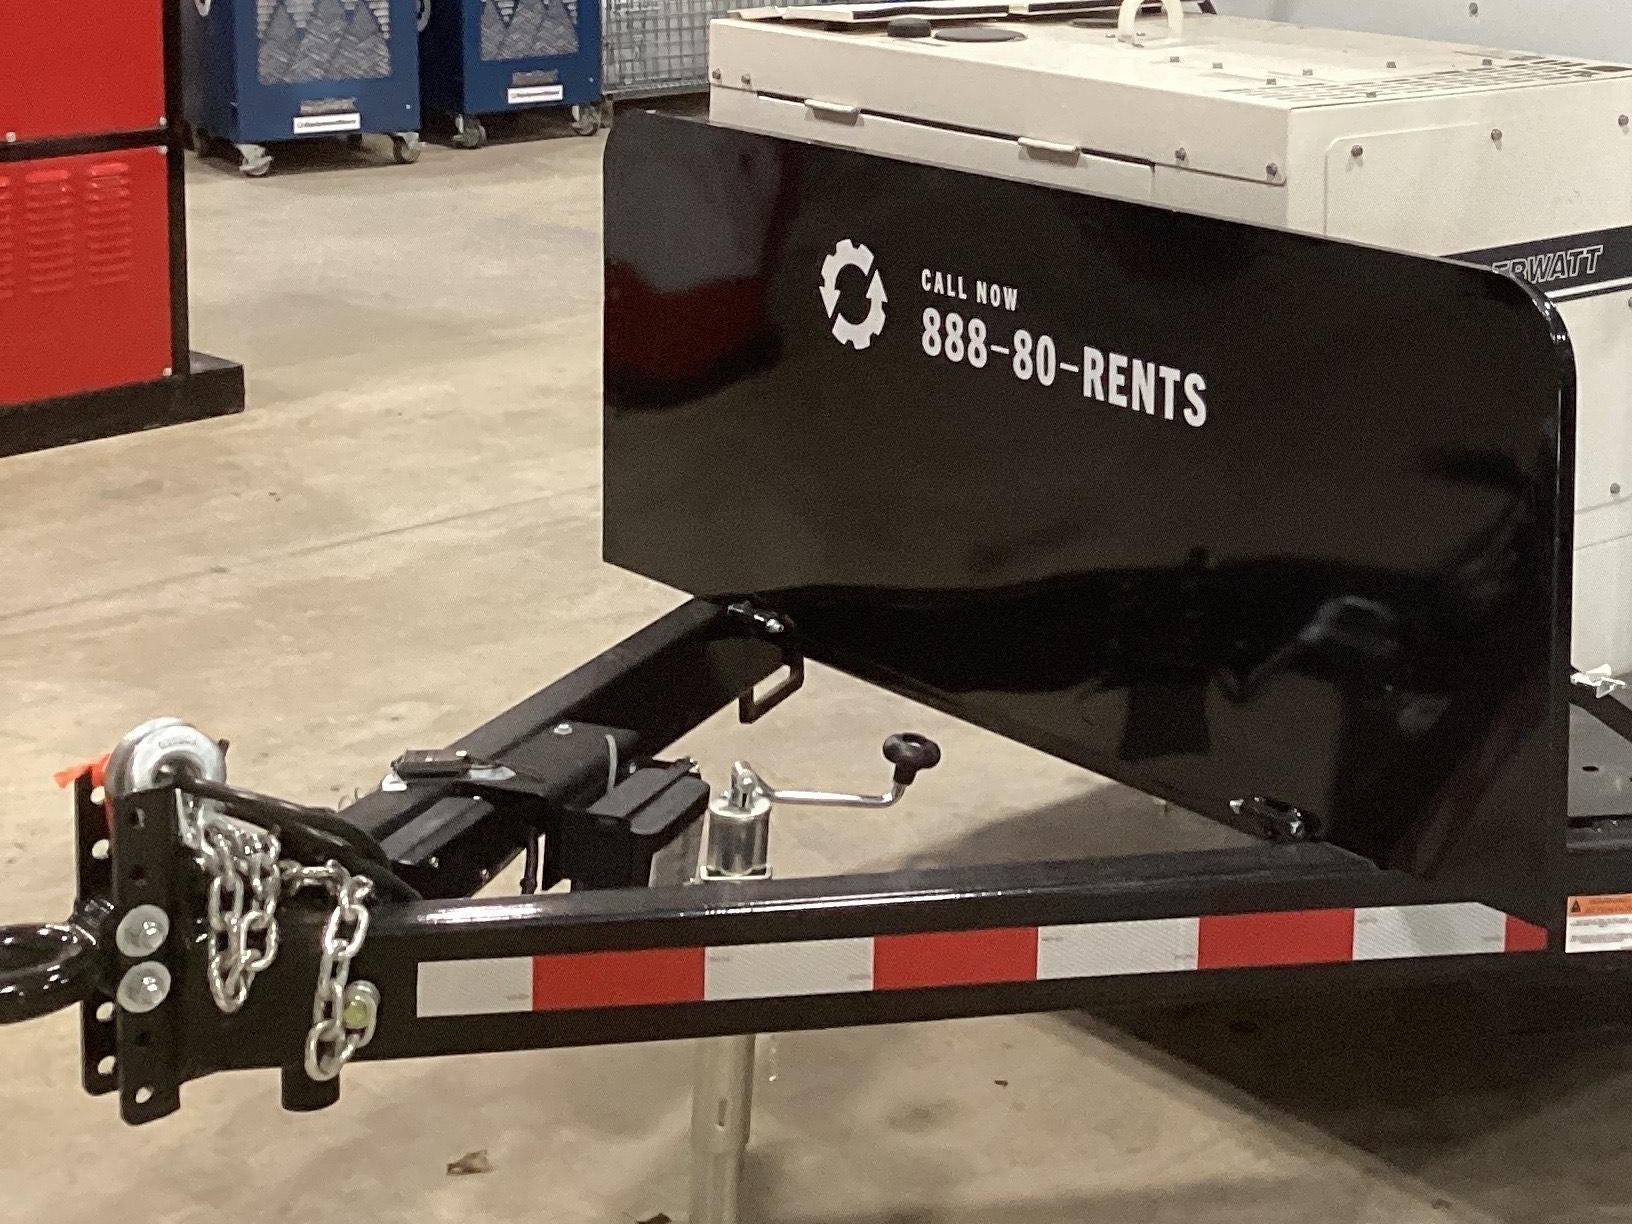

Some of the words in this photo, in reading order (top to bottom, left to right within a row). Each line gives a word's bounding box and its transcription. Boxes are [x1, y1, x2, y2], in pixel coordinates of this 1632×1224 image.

[921, 267, 968, 300] CALL
[976, 280, 1018, 312] NOW
[921, 306, 1207, 428] 888-80-RENTS
